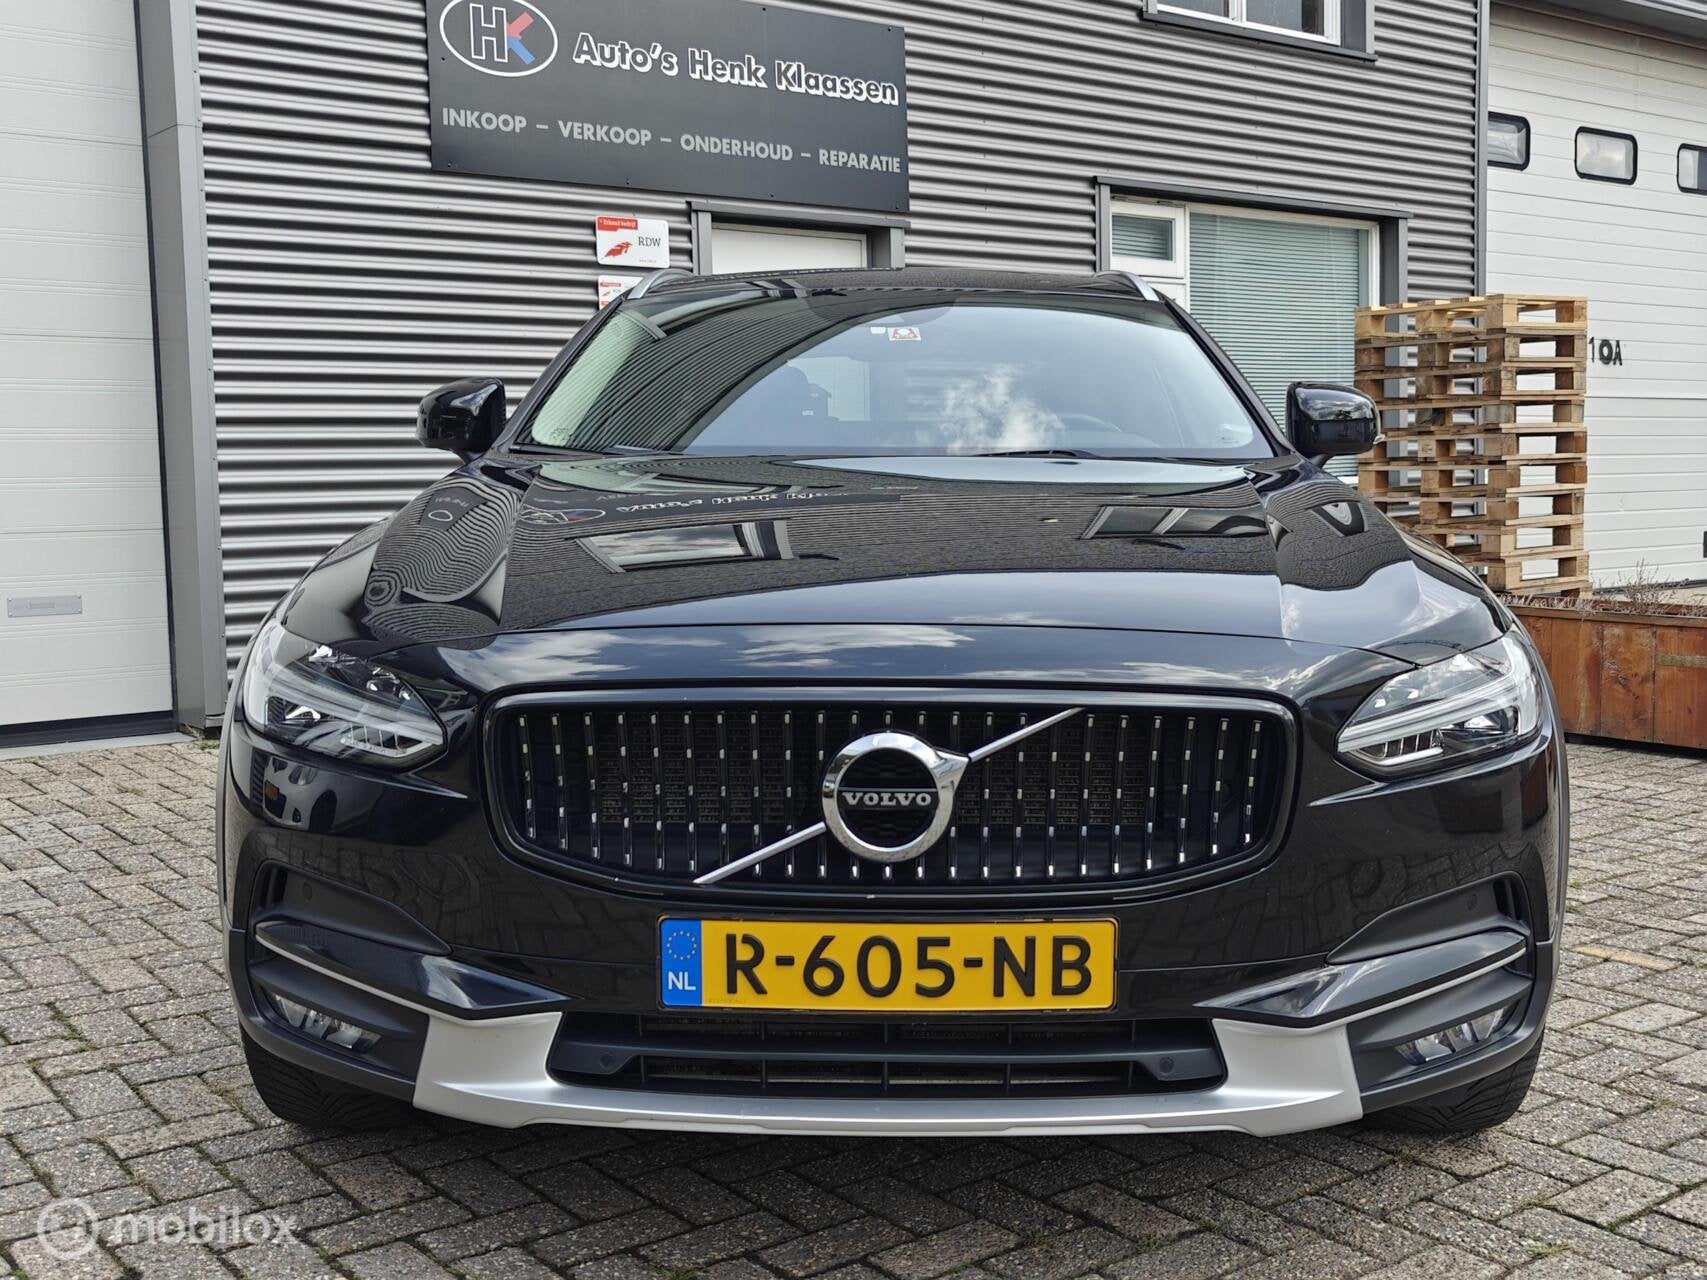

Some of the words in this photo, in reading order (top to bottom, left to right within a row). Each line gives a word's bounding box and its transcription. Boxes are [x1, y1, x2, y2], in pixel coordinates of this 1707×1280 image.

[573, 32, 679, 76] Auto's
[688, 48, 768, 88] Henk
[775, 60, 899, 106] Klaassen
[442, 107, 527, 133] INKOOP
[558, 120, 651, 146] VERKOOP
[680, 134, 793, 161] ONDERHOUD
[819, 149, 901, 173] REPARATIE
[638, 236, 661, 247] RDW
[1588, 336, 1623, 366] 10A
[841, 792, 932, 806] VOLVO
[668, 972, 696, 991] NL
[725, 933, 1092, 998] R-605-NB
